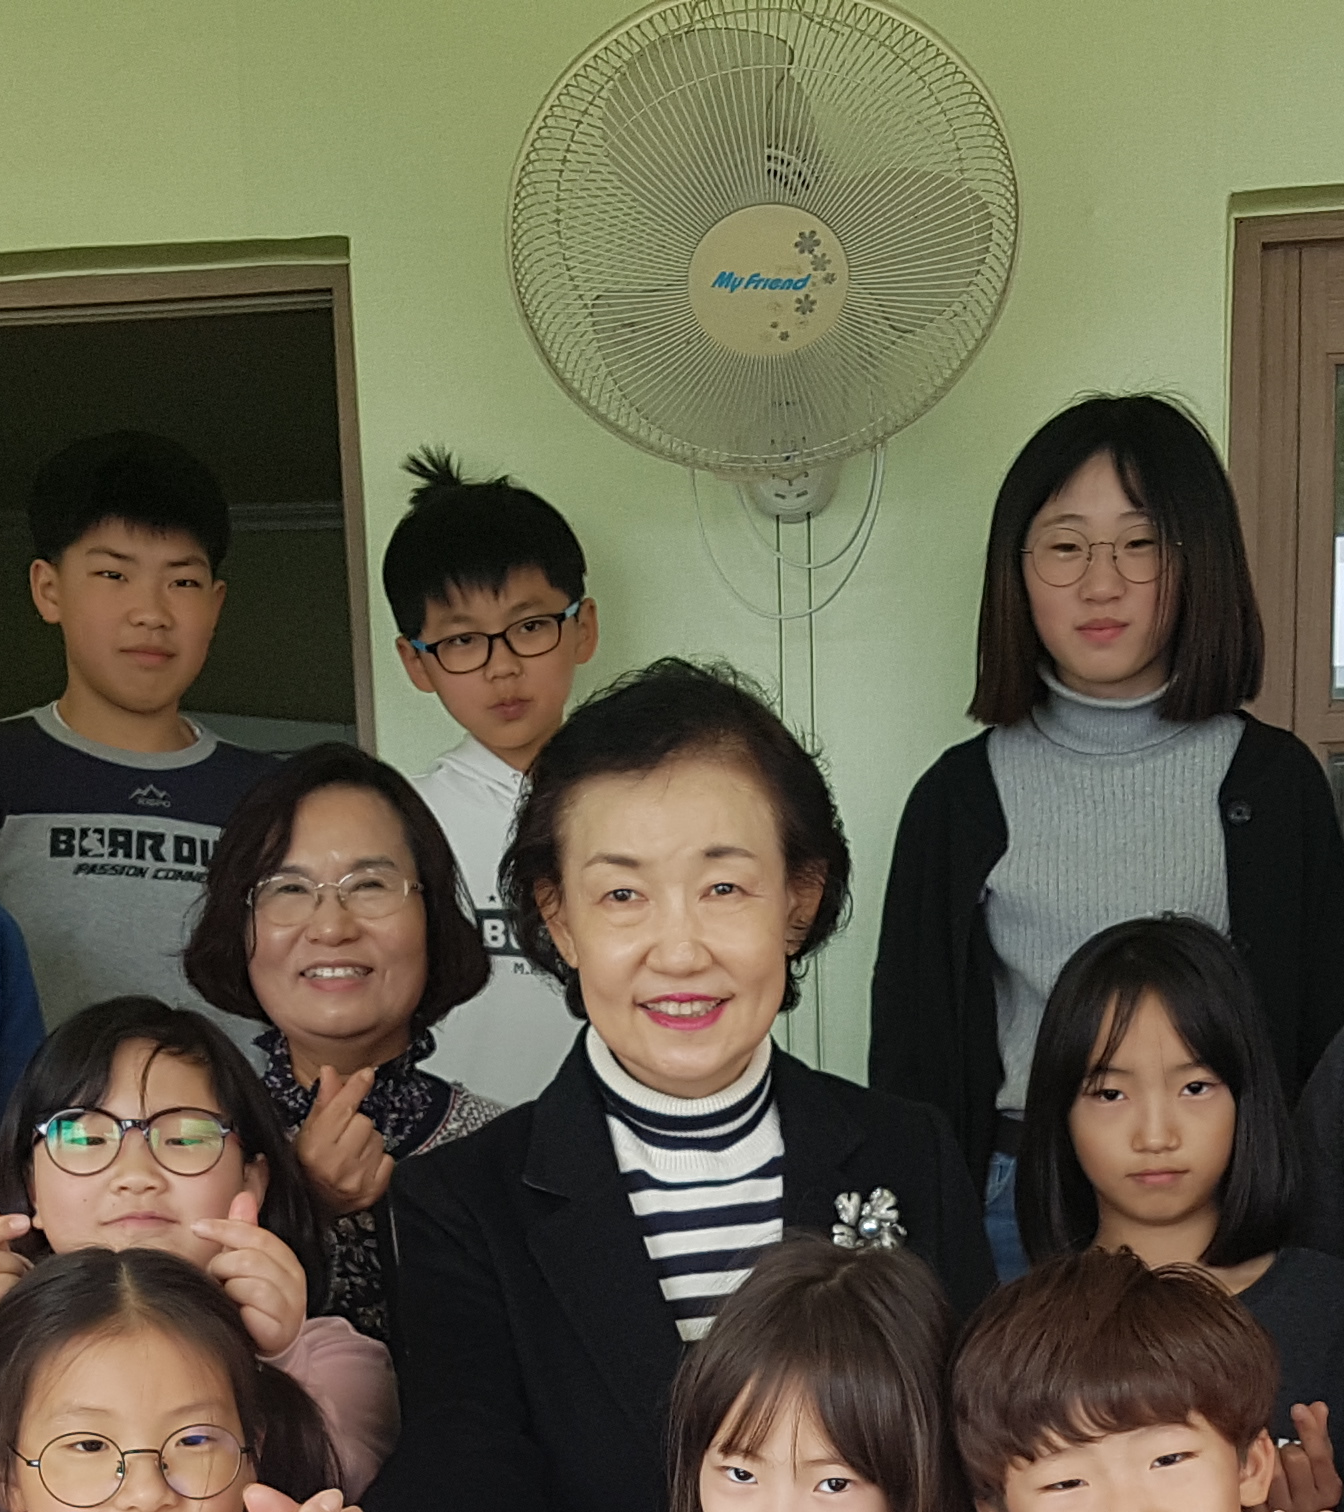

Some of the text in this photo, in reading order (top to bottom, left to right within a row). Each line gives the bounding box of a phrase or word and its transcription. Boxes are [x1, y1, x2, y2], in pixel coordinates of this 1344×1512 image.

[711, 271, 812, 294] My Friend
[74, 863, 149, 877] PASSION
[483, 918, 520, 949] B
